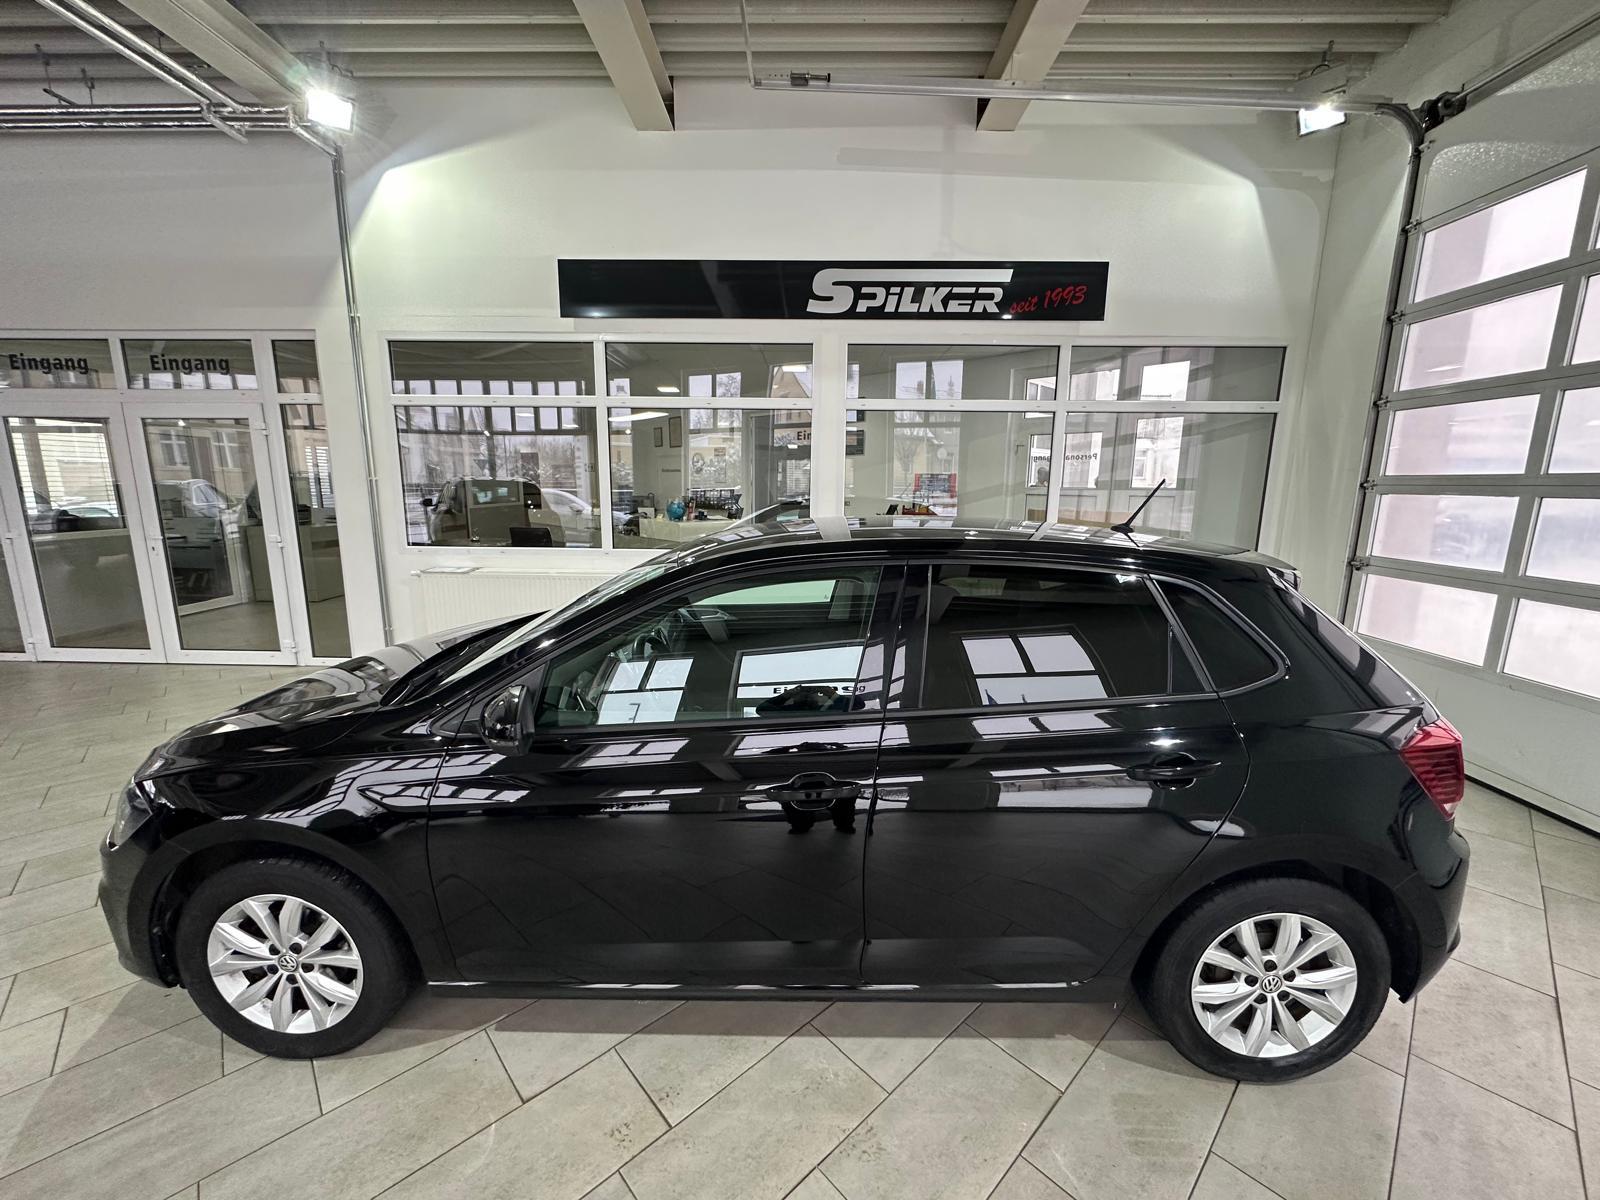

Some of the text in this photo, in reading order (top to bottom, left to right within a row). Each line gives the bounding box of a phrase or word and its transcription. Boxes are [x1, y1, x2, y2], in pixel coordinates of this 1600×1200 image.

[1009, 297, 1038, 315] seit
[1043, 284, 1088, 309] 1993
[8, 353, 90, 375] Eingang
[150, 354, 231, 376] Eingang
